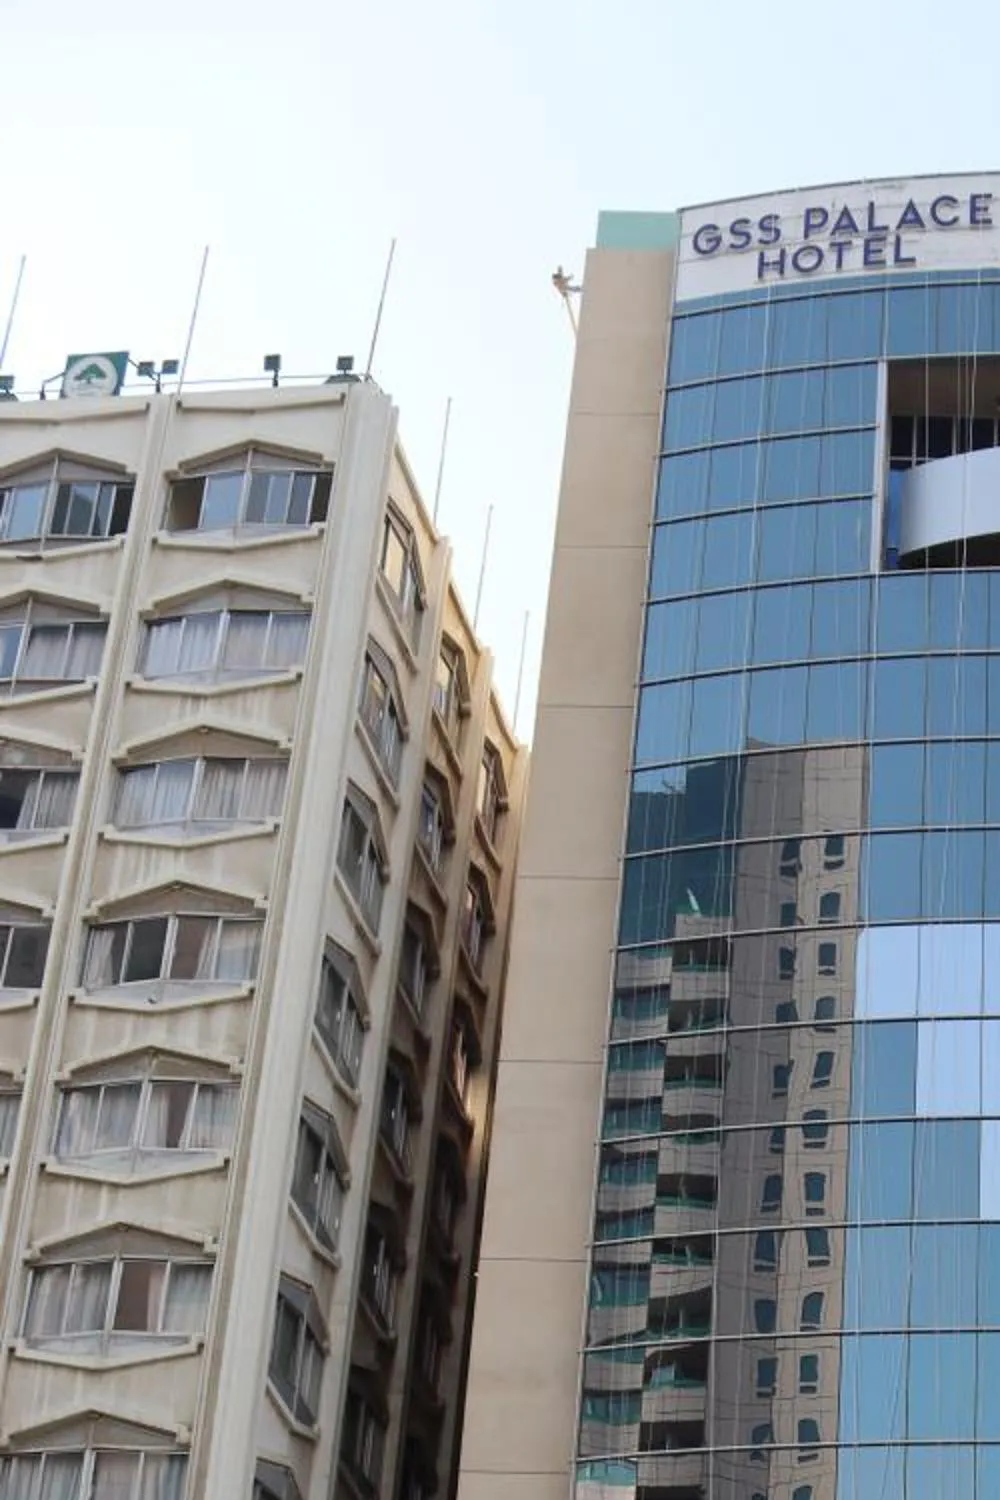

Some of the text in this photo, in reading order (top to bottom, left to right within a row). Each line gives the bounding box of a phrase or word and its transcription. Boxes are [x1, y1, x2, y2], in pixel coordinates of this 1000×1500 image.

[692, 192, 993, 255] GSS PALACE
[757, 234, 917, 279] HOTEL
